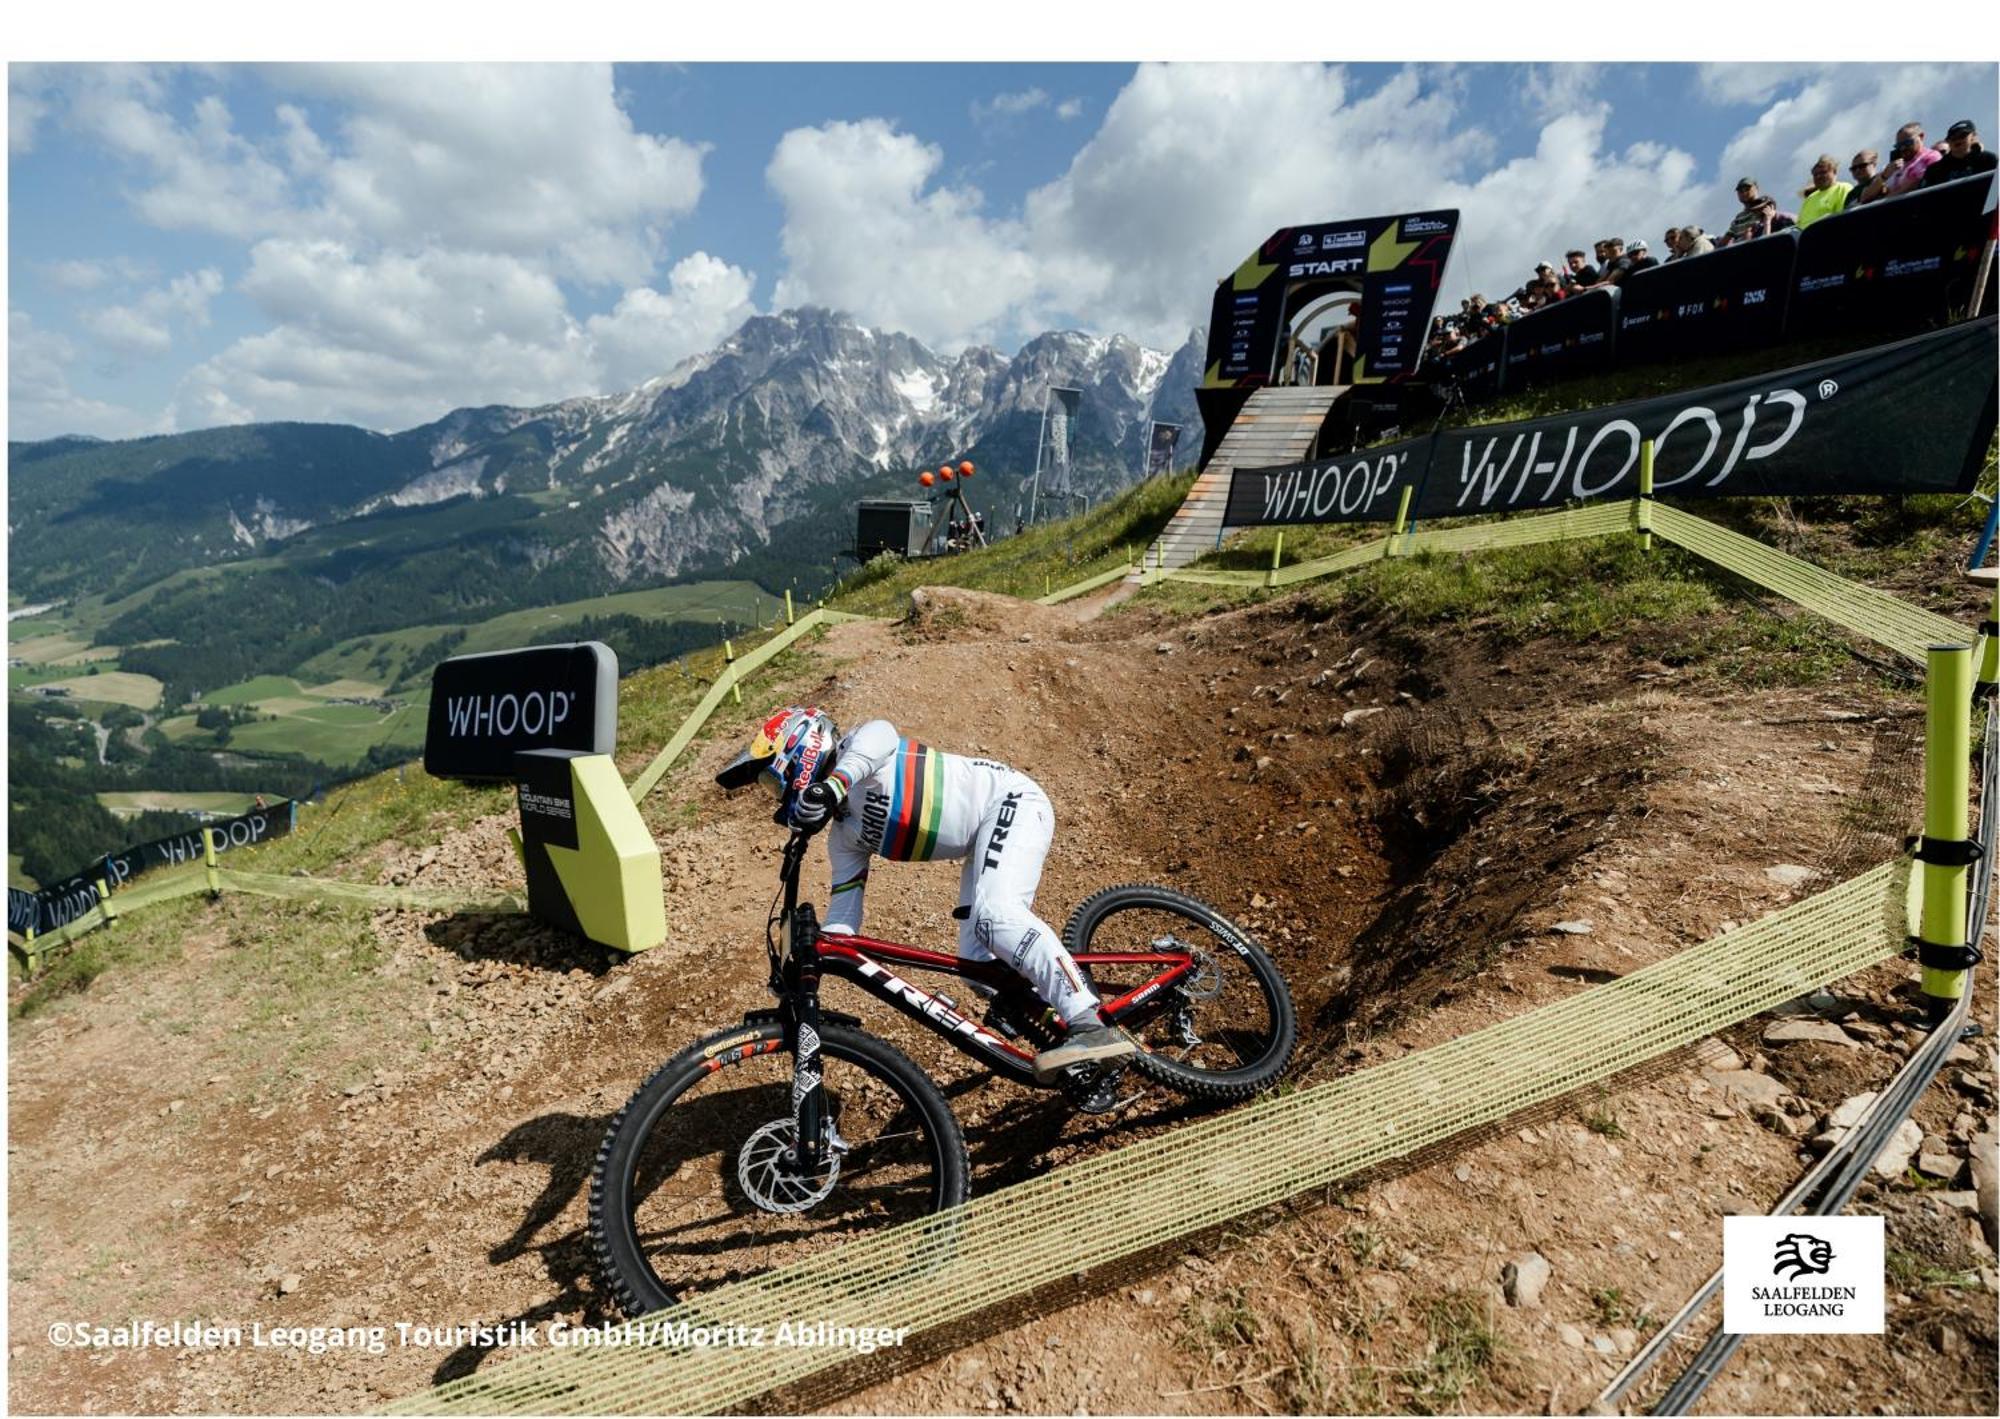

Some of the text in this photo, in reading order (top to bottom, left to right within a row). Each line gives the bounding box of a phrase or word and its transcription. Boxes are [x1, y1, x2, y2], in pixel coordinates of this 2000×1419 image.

[1289, 258, 1363, 277] START
[1686, 303, 1704, 315] FOX
[448, 691, 569, 737] WHOOP
[982, 791, 1024, 874] TREK
[1208, 920, 1239, 944] SWISS
[857, 953, 1007, 1047] TREK
[703, 1030, 757, 1058] Continental
